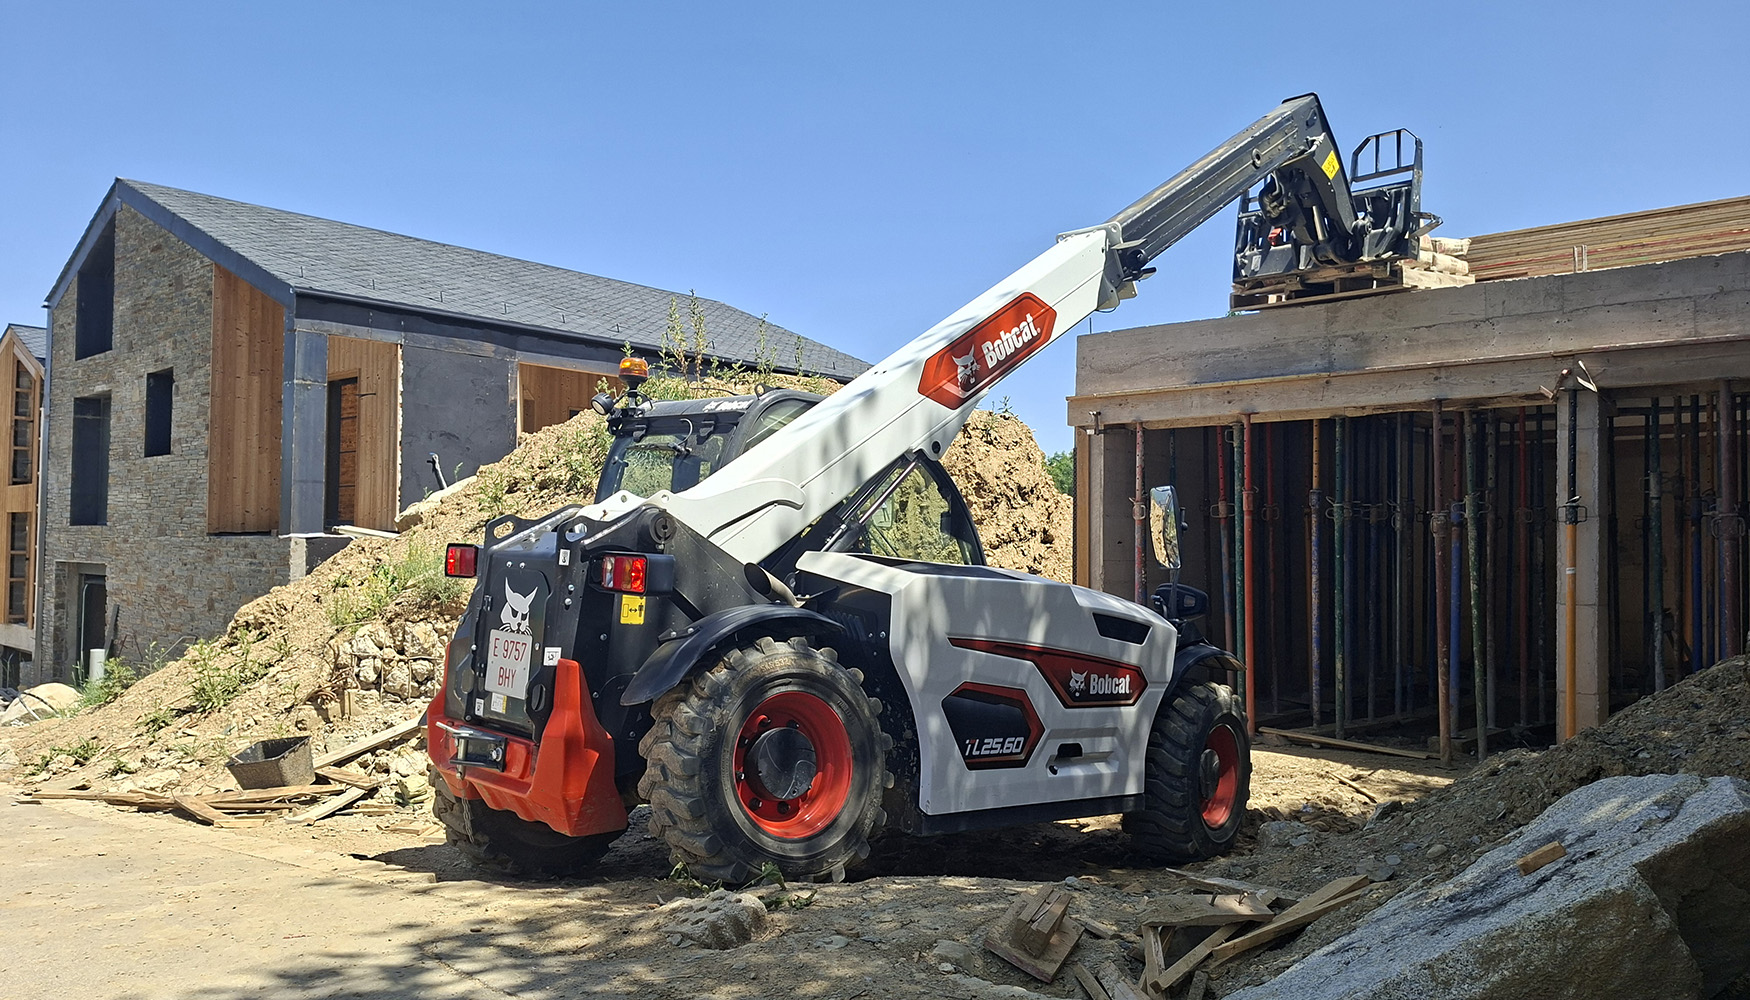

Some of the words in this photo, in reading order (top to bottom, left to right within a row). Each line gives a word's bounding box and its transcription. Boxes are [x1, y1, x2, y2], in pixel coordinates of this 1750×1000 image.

[981, 312, 1038, 370] Bobcat
[493, 637, 500, 657] E
[502, 639, 528, 662] 9757
[497, 666, 517, 689] BHY
[1089, 673, 1131, 695] Bobcat
[965, 736, 1025, 756] TL25.60
